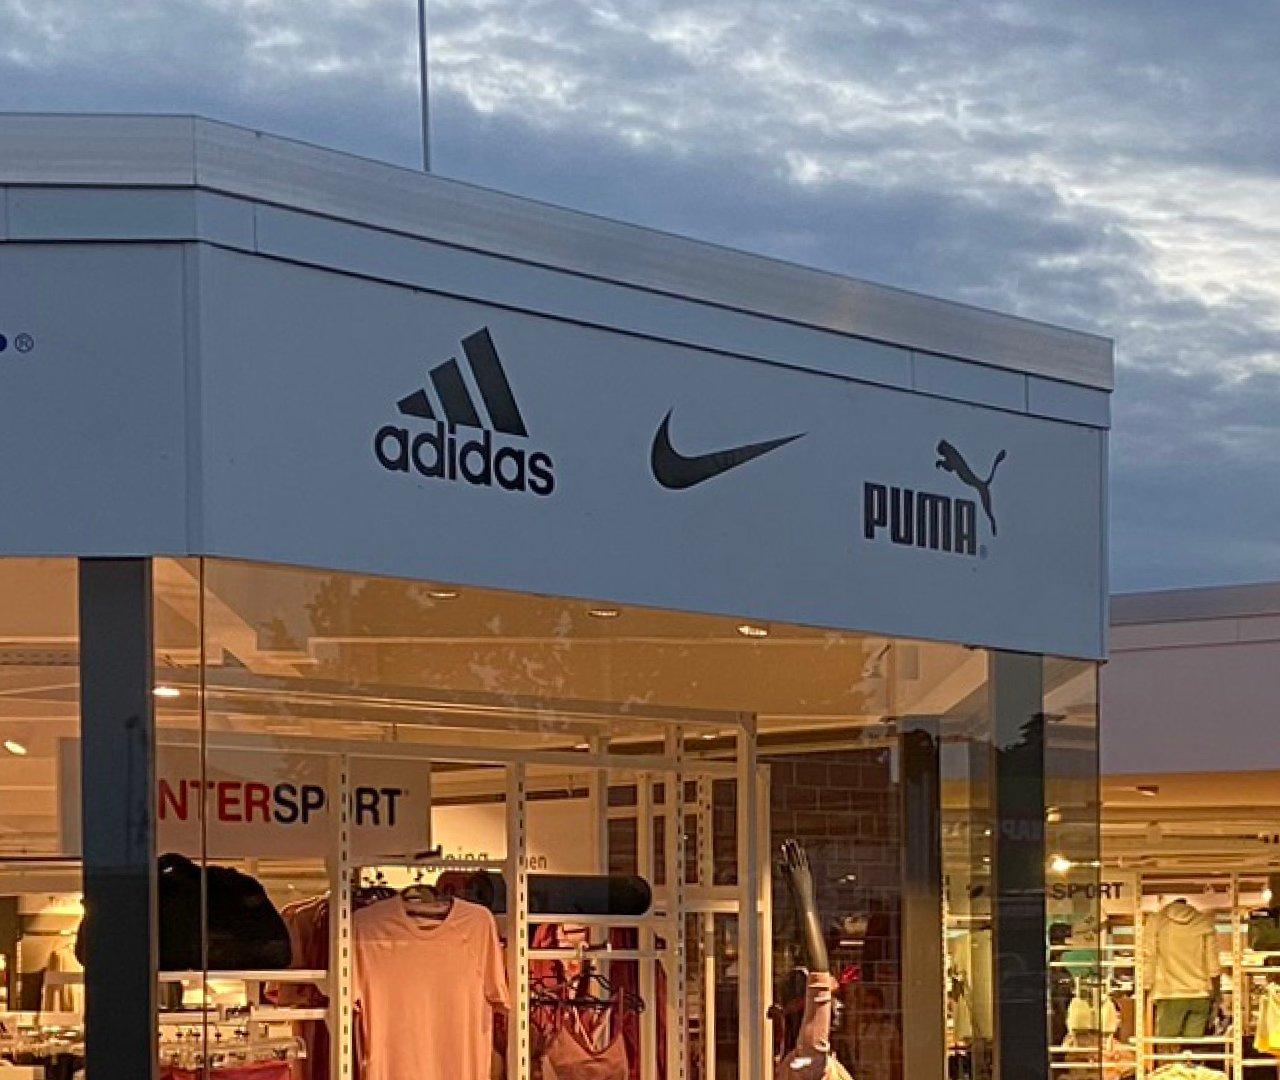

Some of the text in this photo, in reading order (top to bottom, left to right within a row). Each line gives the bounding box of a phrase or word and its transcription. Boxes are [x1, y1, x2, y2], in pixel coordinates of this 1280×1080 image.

[374, 420, 555, 496] adidas
[863, 482, 977, 556] PUMA
[157, 778, 403, 826] NTERSPRT
